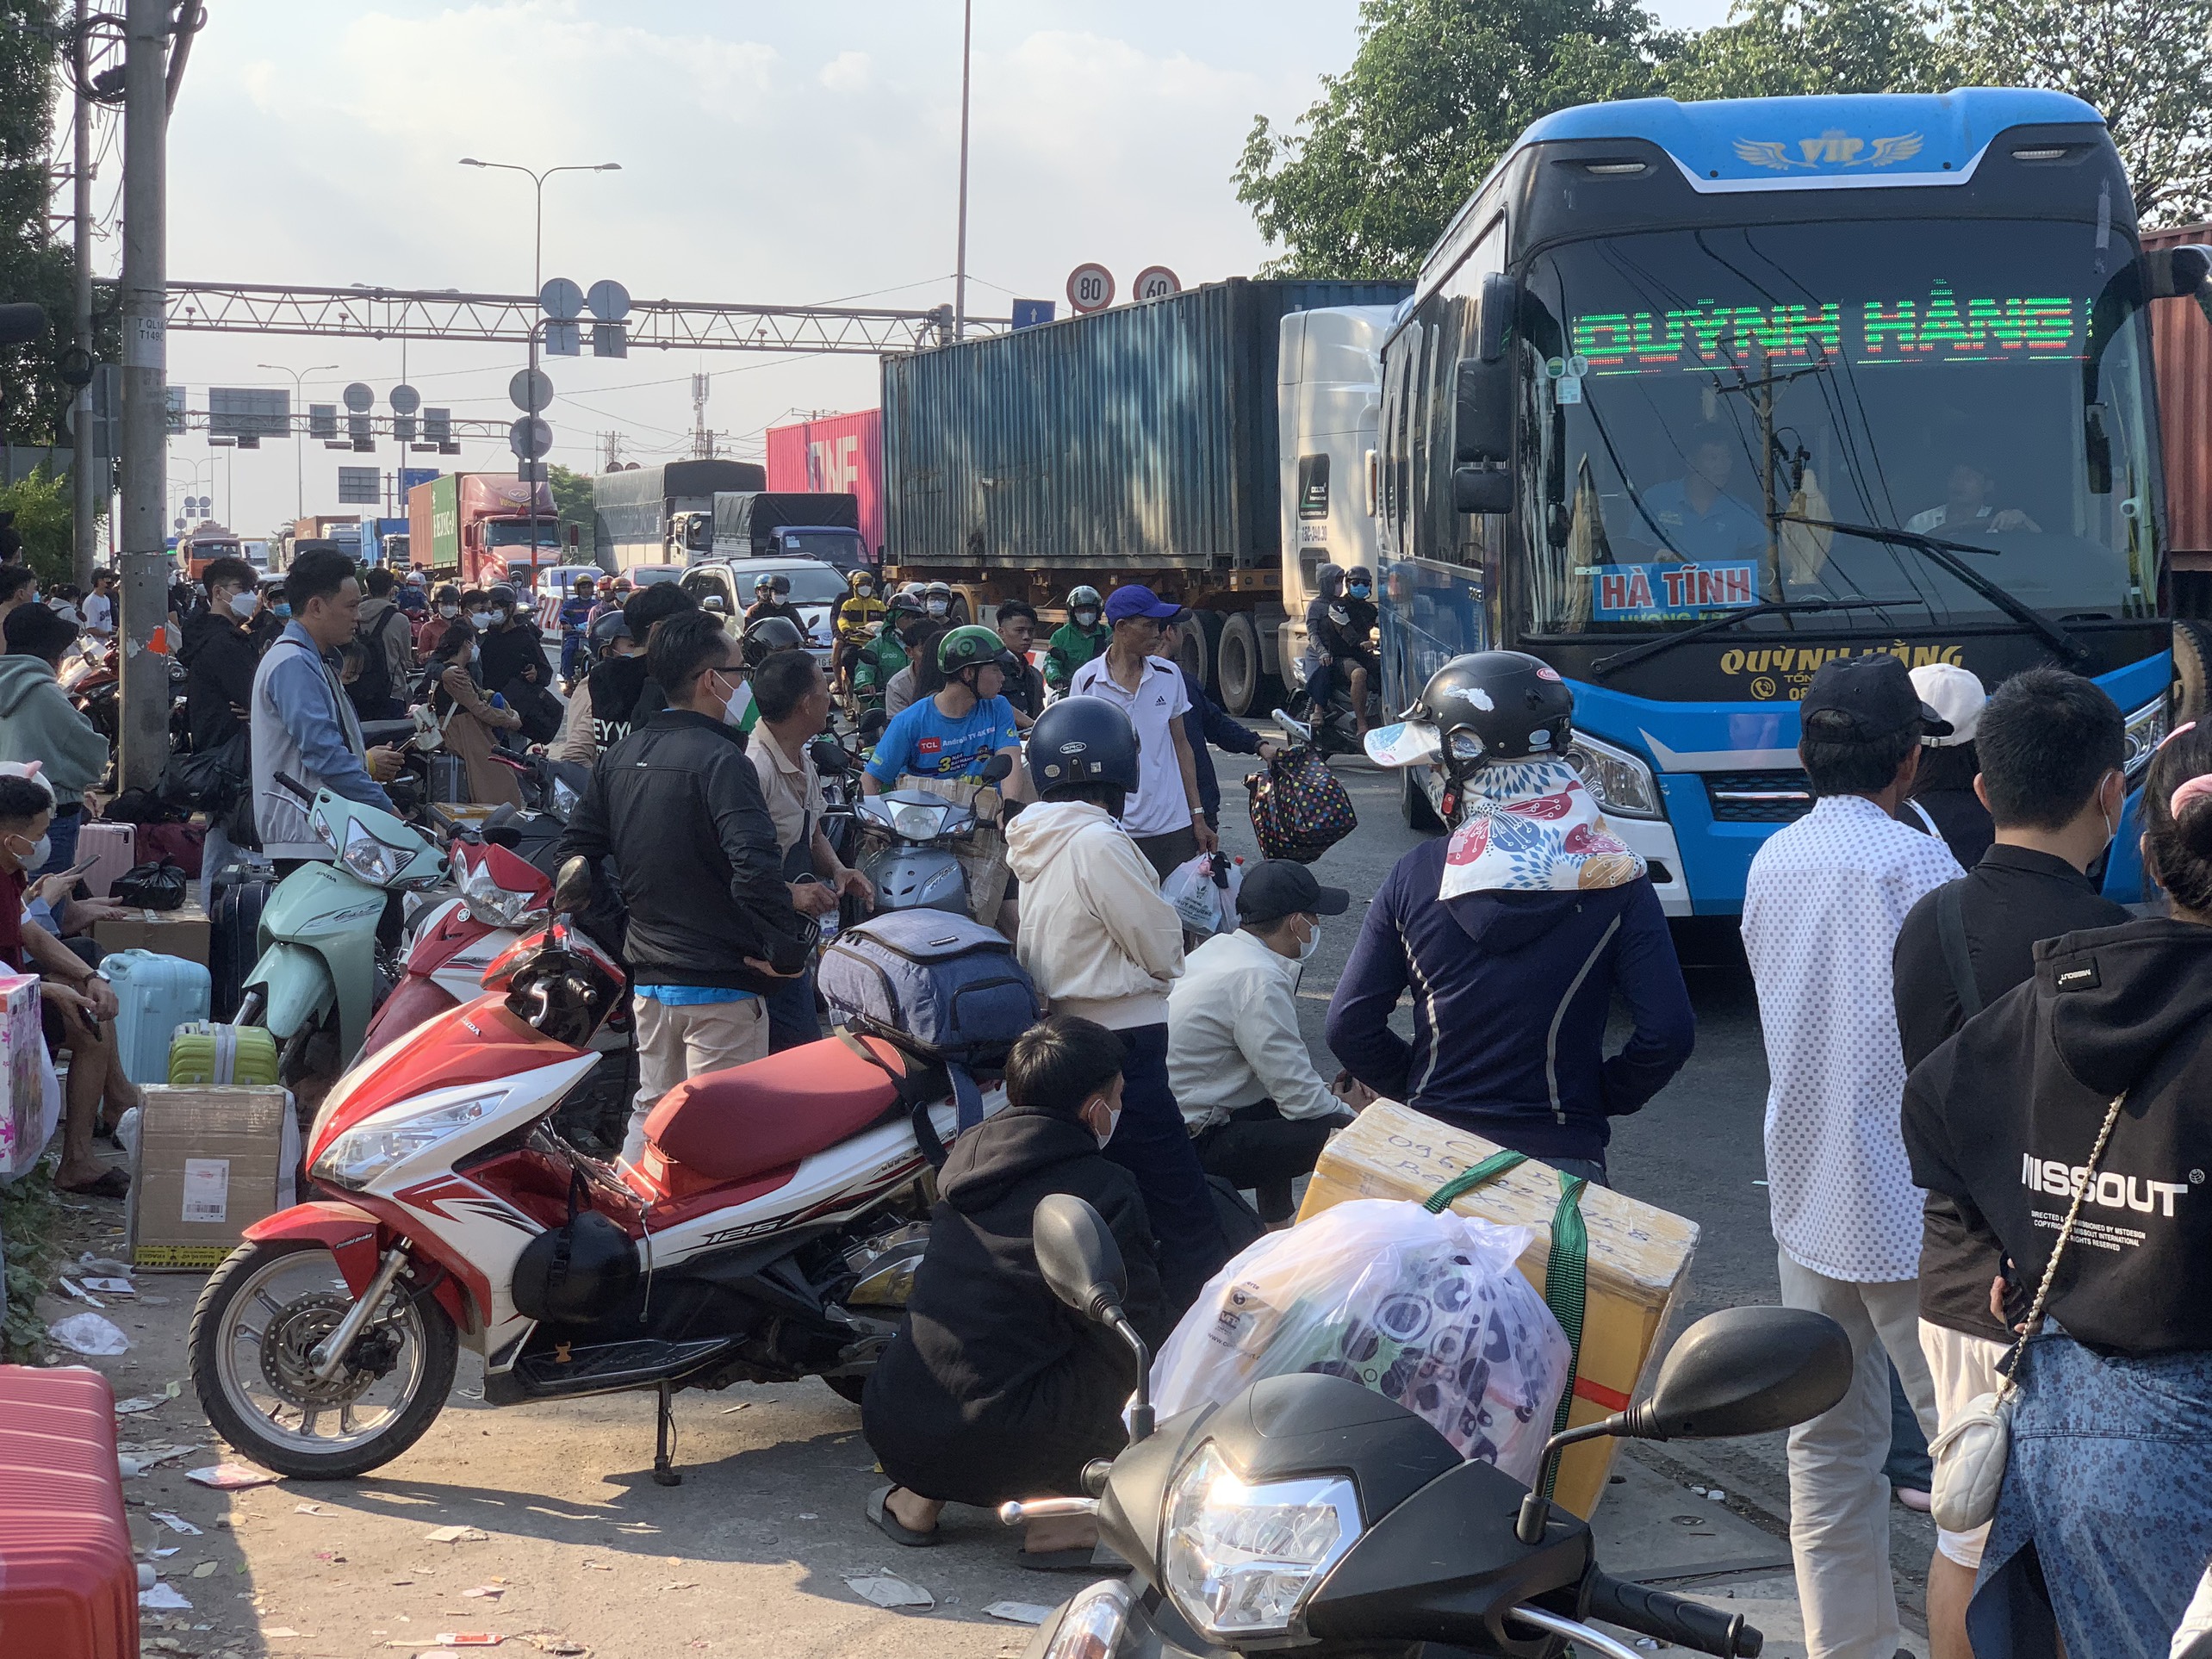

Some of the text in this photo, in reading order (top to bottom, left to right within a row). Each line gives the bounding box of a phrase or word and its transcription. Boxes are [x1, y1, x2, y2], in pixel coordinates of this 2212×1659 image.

[1799, 138, 1864, 162] VIP
[1080, 277, 1102, 301] 80
[1146, 280, 1168, 299] 60
[1600, 563, 1753, 611] HÀ TĨNH
[593, 718, 614, 742] EY
[938, 756, 952, 773] 3
[706, 1219, 780, 1245] 125
[2070, 1234, 2121, 1252] RIGHTS RESERVED
[2098, 1232, 2141, 1247] INTERNATIONAL
